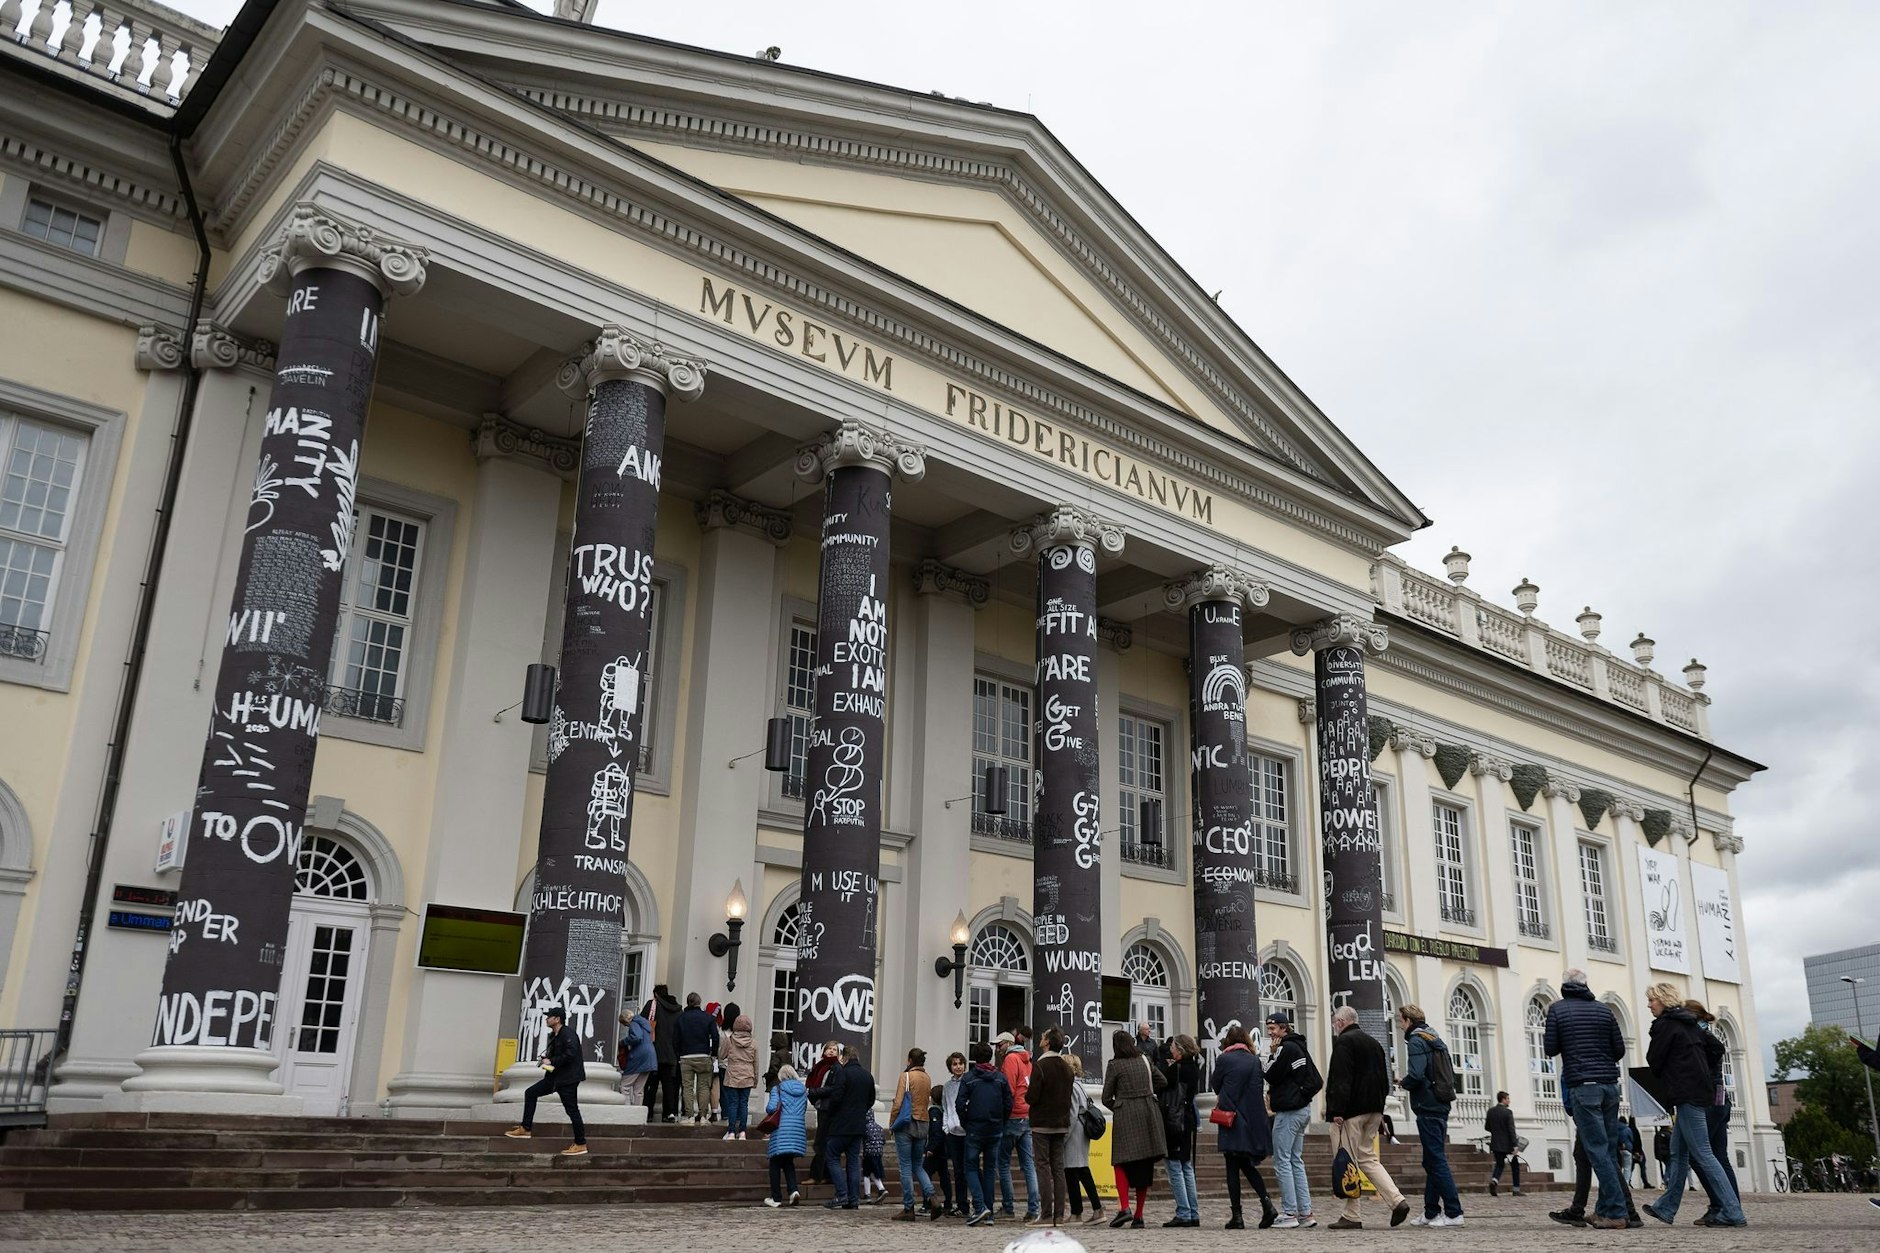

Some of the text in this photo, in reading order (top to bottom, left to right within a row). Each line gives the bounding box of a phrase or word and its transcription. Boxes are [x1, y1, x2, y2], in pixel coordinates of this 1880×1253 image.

[700, 277, 1214, 525] MVSEVM FRIDERICIANVM
[581, 572, 651, 619] WHO?
[858, 594, 886, 627] AM
[848, 618, 888, 650] NOT
[1046, 611, 1084, 636] FIT
[1209, 654, 1229, 665] BLUE
[1045, 693, 1081, 723] GET
[1223, 710, 1244, 722] BENE
[244, 723, 271, 734] 2020
[1045, 722, 1083, 752] GIVE
[832, 797, 866, 816] STOP
[201, 811, 238, 841] TO
[832, 870, 862, 892] USE
[841, 892, 855, 903] IT
[1329, 919, 1376, 963] lead
